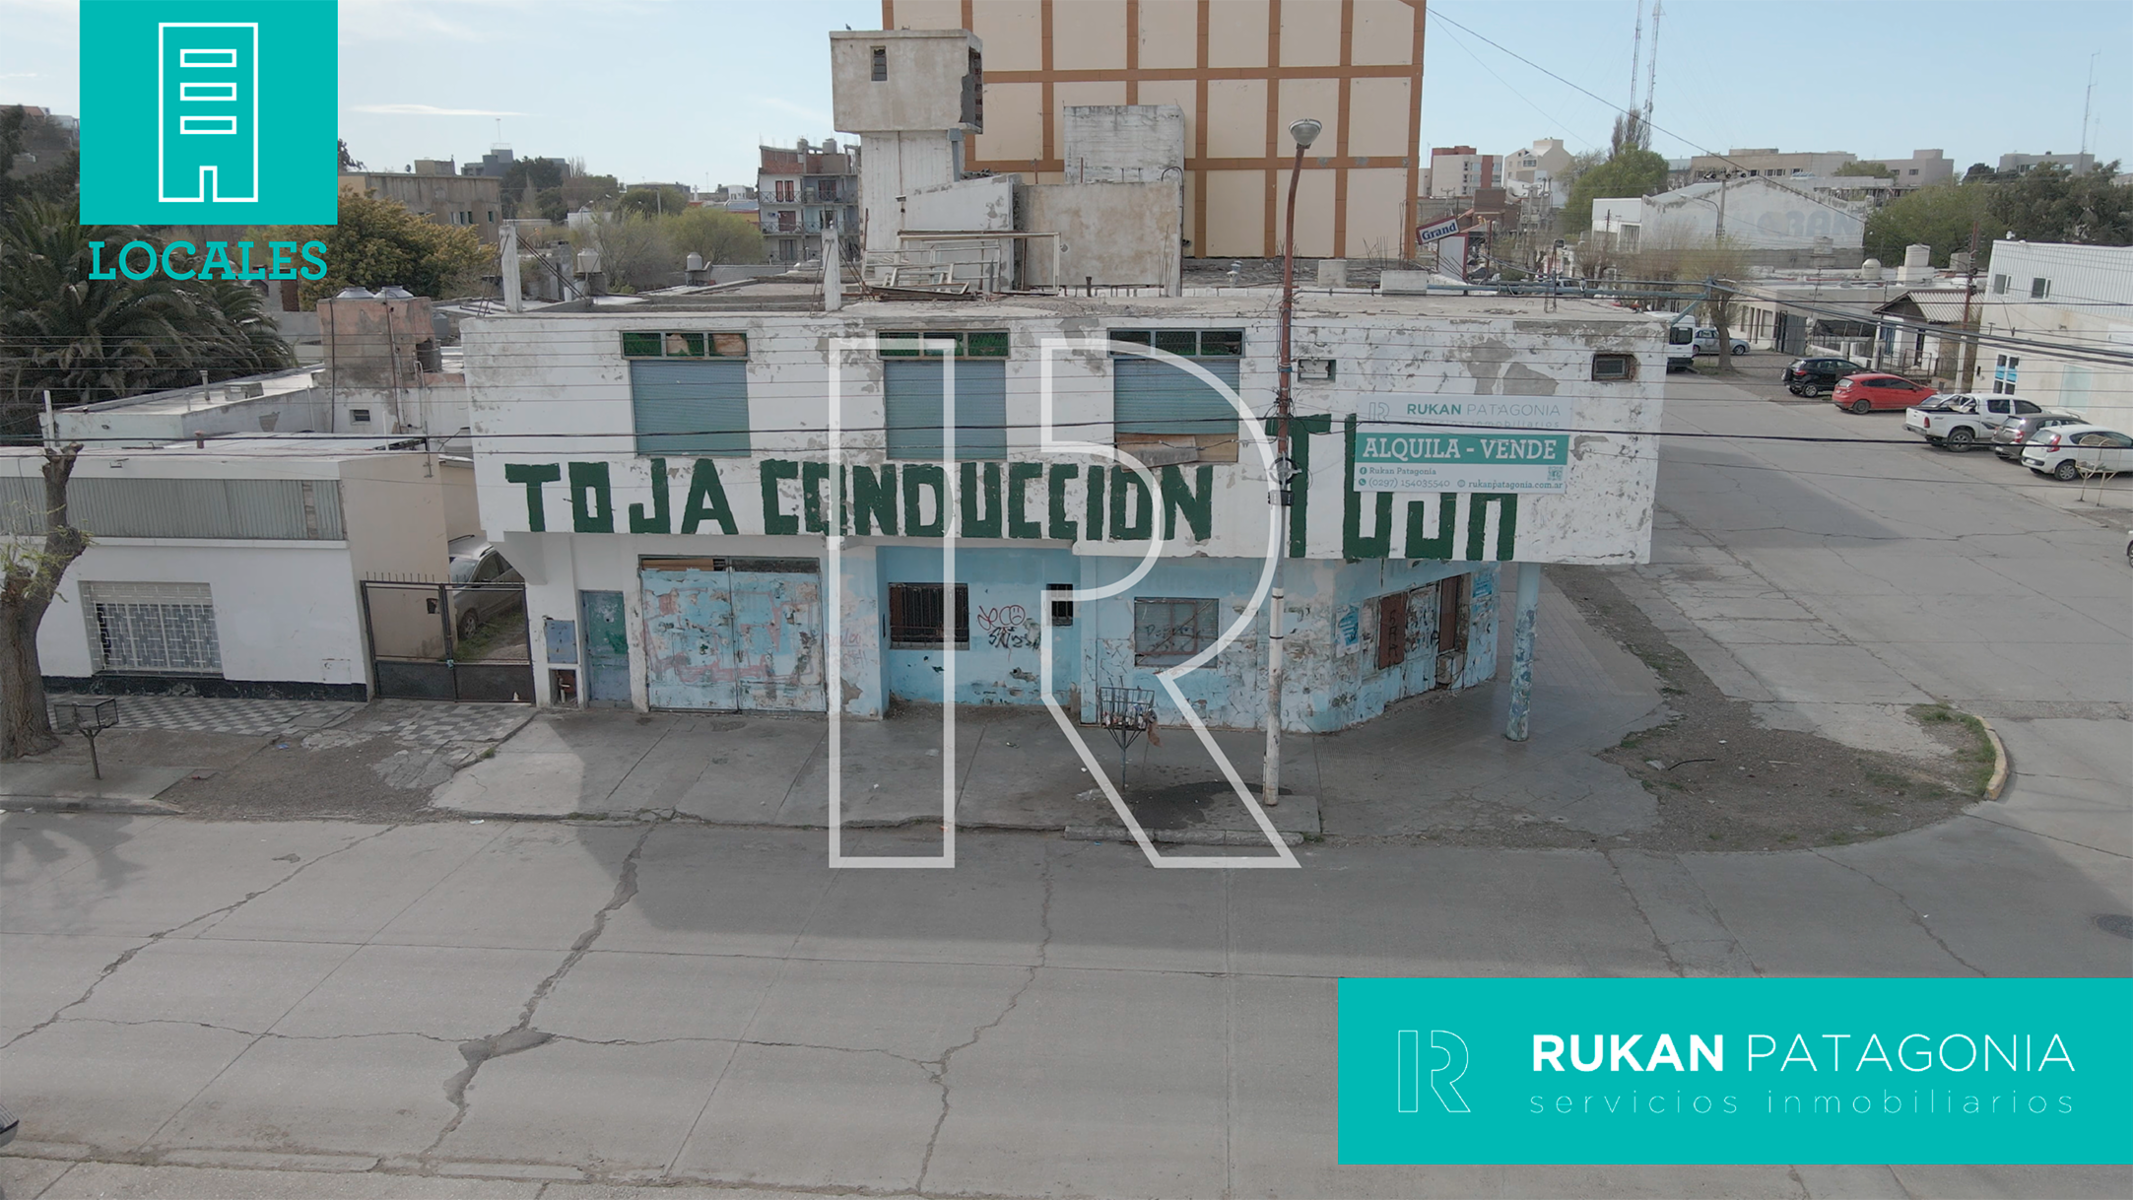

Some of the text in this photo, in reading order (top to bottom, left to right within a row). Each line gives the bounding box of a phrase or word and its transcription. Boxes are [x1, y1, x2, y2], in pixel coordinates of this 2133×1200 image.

[1422, 222, 1457, 240] Grand
[1407, 403, 1561, 416] RUKAN PATAGONIA
[1362, 438, 1461, 461] ALQUILA
[1480, 439, 1557, 459] VENDE
[1369, 467, 1436, 477] Rukan Patagonia
[1369, 478, 1450, 488] (0297) 154035540
[1468, 478, 1564, 490] rukanpatagonia.com.ar
[504, 458, 1214, 541] TOJA CONDUCCION
